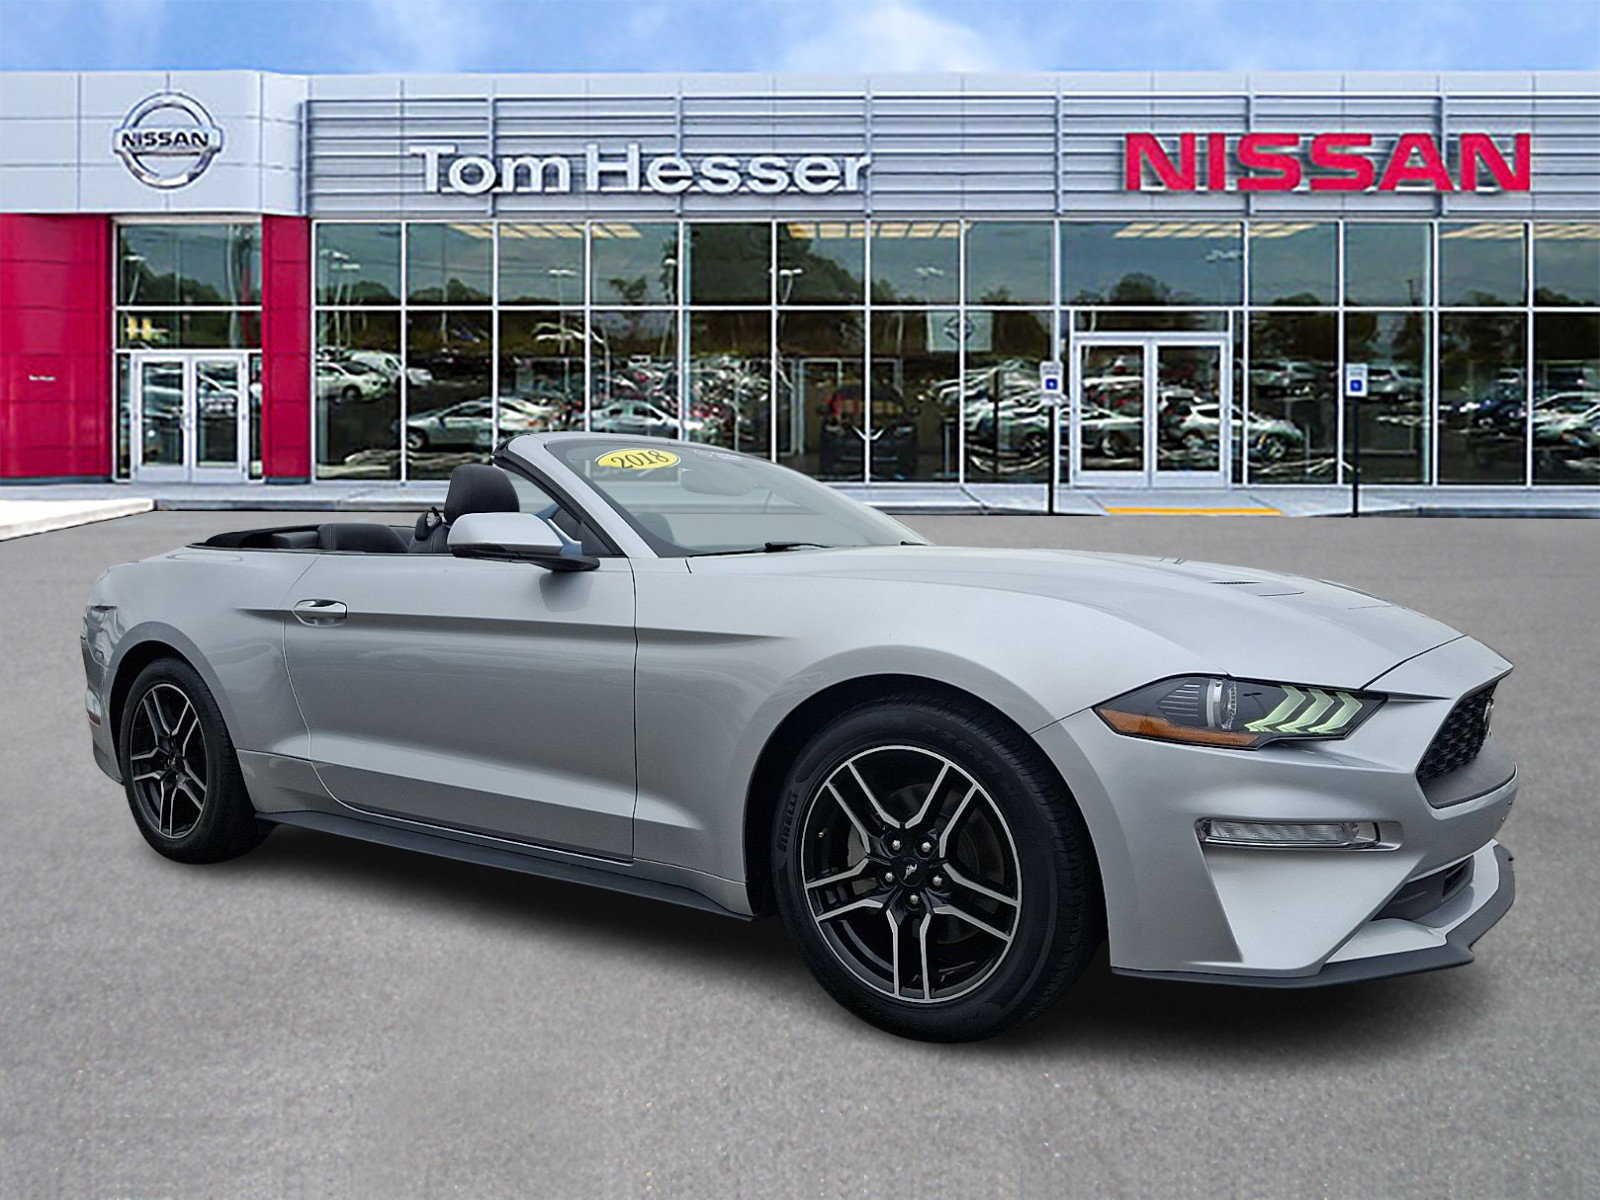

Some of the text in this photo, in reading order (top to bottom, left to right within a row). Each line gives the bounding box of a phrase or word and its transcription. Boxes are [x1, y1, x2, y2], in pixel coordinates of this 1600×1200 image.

[121, 131, 209, 148] NISSAN
[409, 143, 871, 194] Tom Hesser
[1125, 132, 1531, 191] NISSAN
[610, 450, 669, 469] 2018
